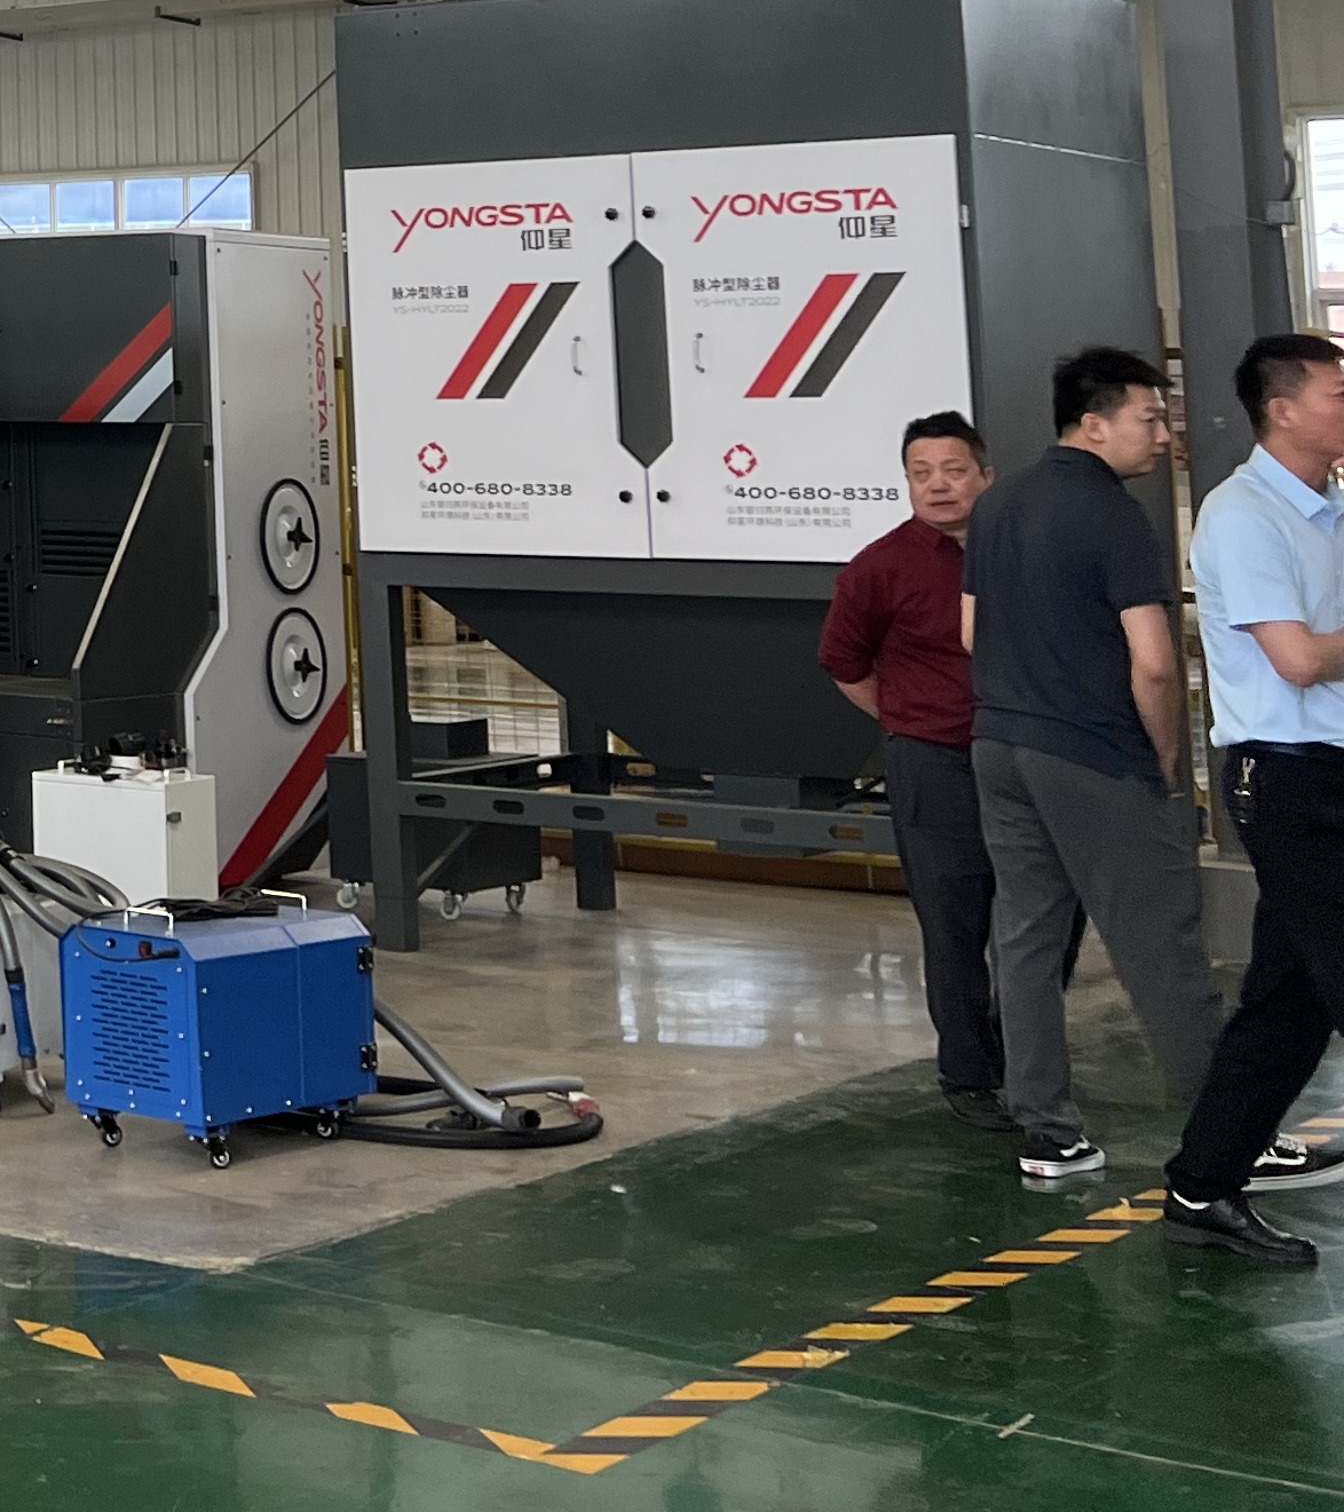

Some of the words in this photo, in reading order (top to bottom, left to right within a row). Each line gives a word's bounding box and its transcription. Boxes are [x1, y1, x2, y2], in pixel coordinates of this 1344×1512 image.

[691, 187, 899, 243] YONGSTA
[838, 214, 898, 240] 仰星
[391, 202, 573, 253] YONGSTA
[520, 227, 573, 251] 仰星
[392, 286, 469, 300] 脉冲型除尘器
[692, 276, 780, 292] 脉冲型除尘器
[302, 269, 328, 435] YONGSTA
[427, 482, 572, 496] 400-680-8338
[734, 487, 900, 501] 400-680-8338
